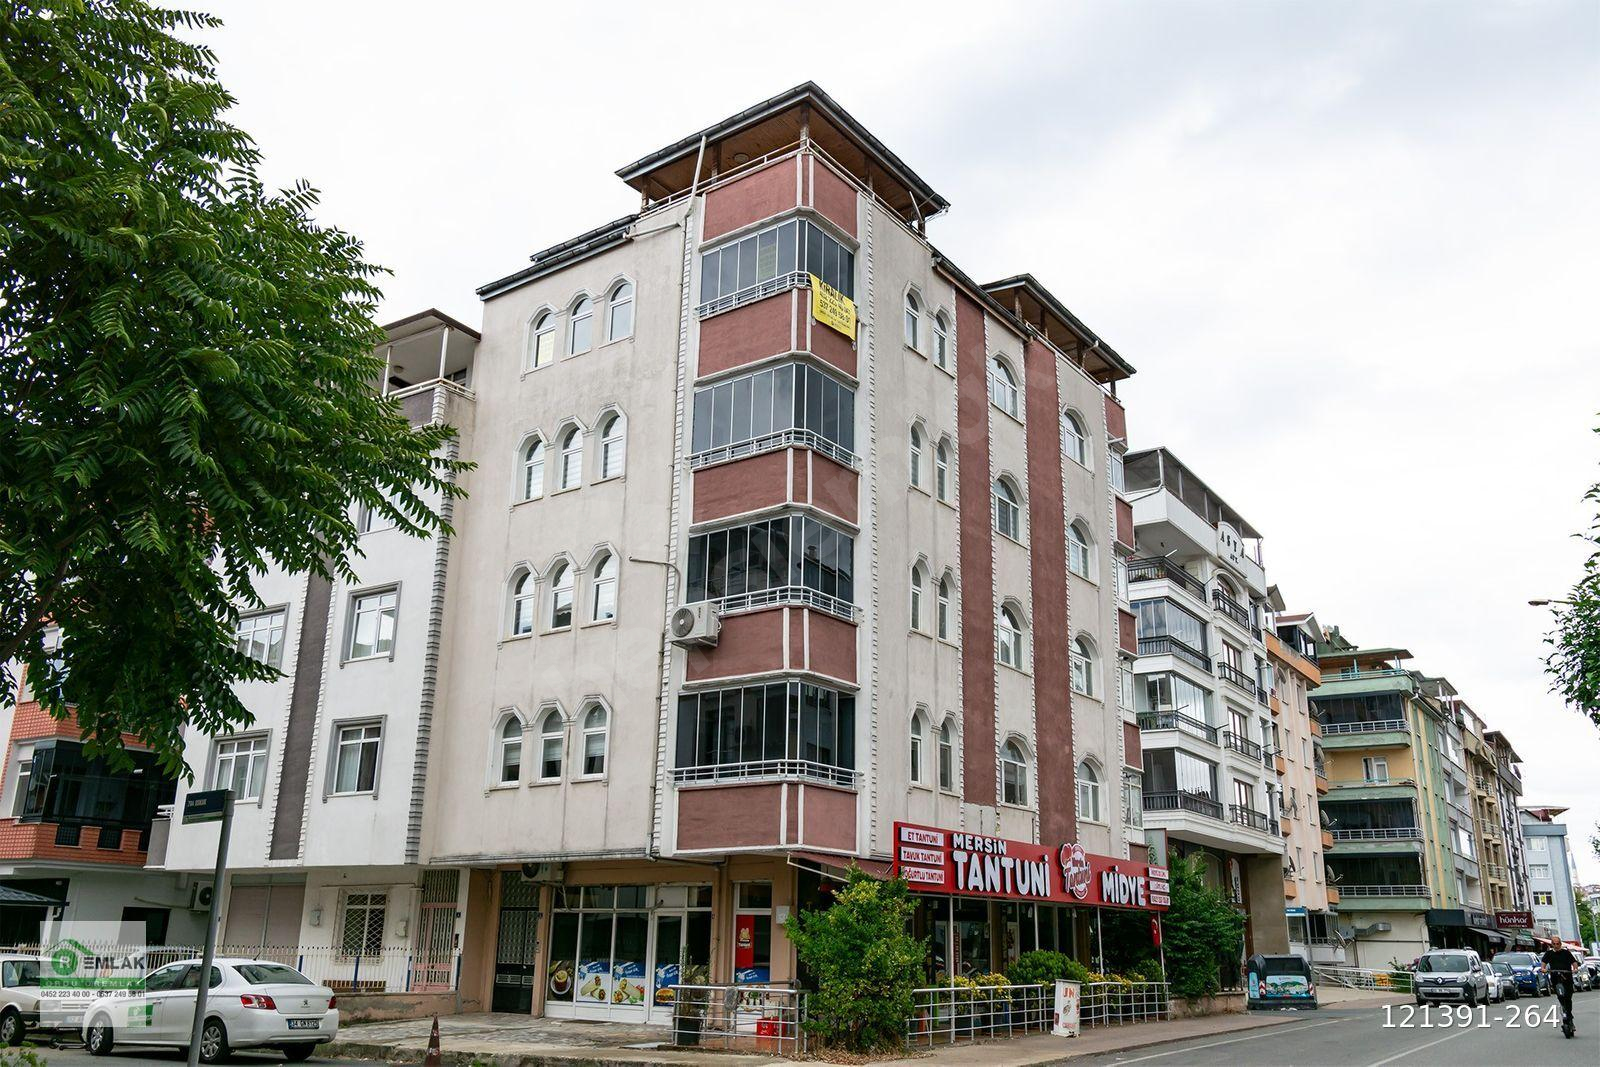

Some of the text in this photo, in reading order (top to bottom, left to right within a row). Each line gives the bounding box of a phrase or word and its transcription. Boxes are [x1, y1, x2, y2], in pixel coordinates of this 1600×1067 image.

[907, 831, 914, 841] ET
[903, 850, 920, 861] TAVUK
[953, 850, 1051, 897] TANTUNİ
[1102, 865, 1146, 906] MİDYE
